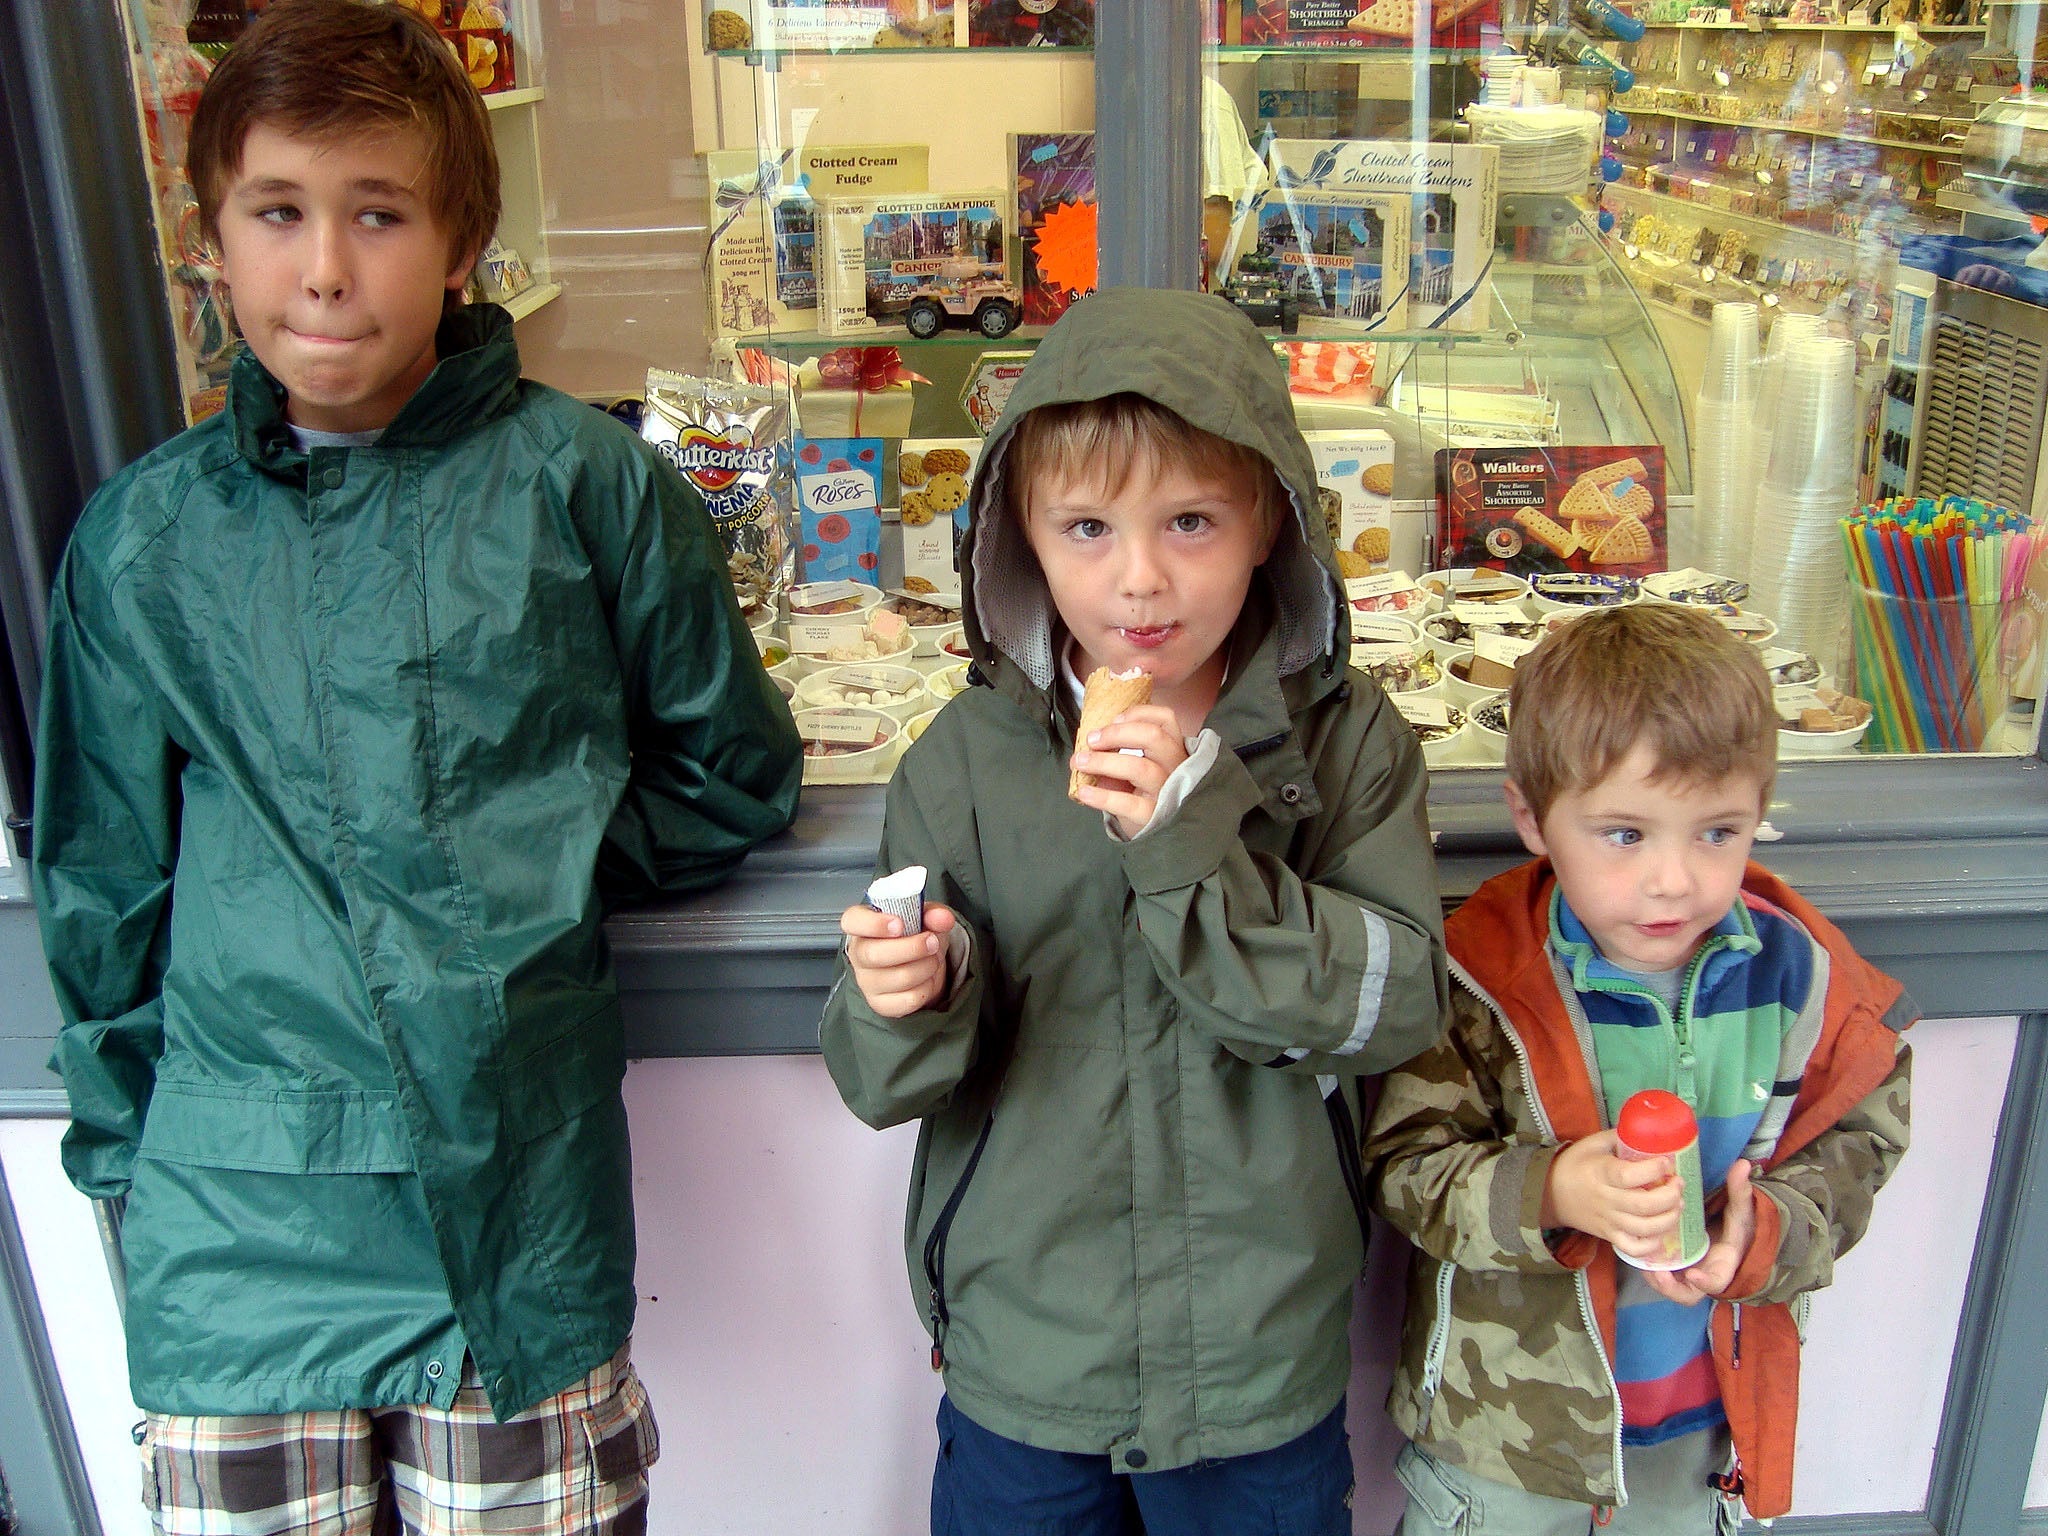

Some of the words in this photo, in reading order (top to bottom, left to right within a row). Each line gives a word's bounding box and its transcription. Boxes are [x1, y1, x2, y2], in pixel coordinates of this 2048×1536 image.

[1289, 8, 1357, 19] SHORTBREAD
[1301, 18, 1344, 27] TRIANGLES
[810, 157, 856, 168] Clotted
[858, 156, 898, 167] Cream
[1360, 152, 1409, 167] Clotted
[1411, 153, 1455, 169] Cream
[835, 174, 873, 185] Fudge
[1343, 168, 1415, 184] Shortbread
[1419, 171, 1474, 188] Buttons
[877, 202, 923, 213] CLOTTED
[925, 201, 961, 211] CREAM
[962, 199, 996, 209] FUDGE
[726, 238, 747, 246] Made
[720, 248, 753, 257] Delicious
[720, 258, 747, 266] Clotted
[748, 257, 773, 265] Cream
[1284, 254, 1353, 268] CANERBURY
[656, 440, 773, 473] Butterkist
[1482, 462, 1545, 474] Walkers
[704, 483, 758, 517] NEMA
[812, 483, 873, 505] Roses
[1484, 496, 1545, 505] SHORTBREAD
[728, 493, 771, 531] POPCORN
